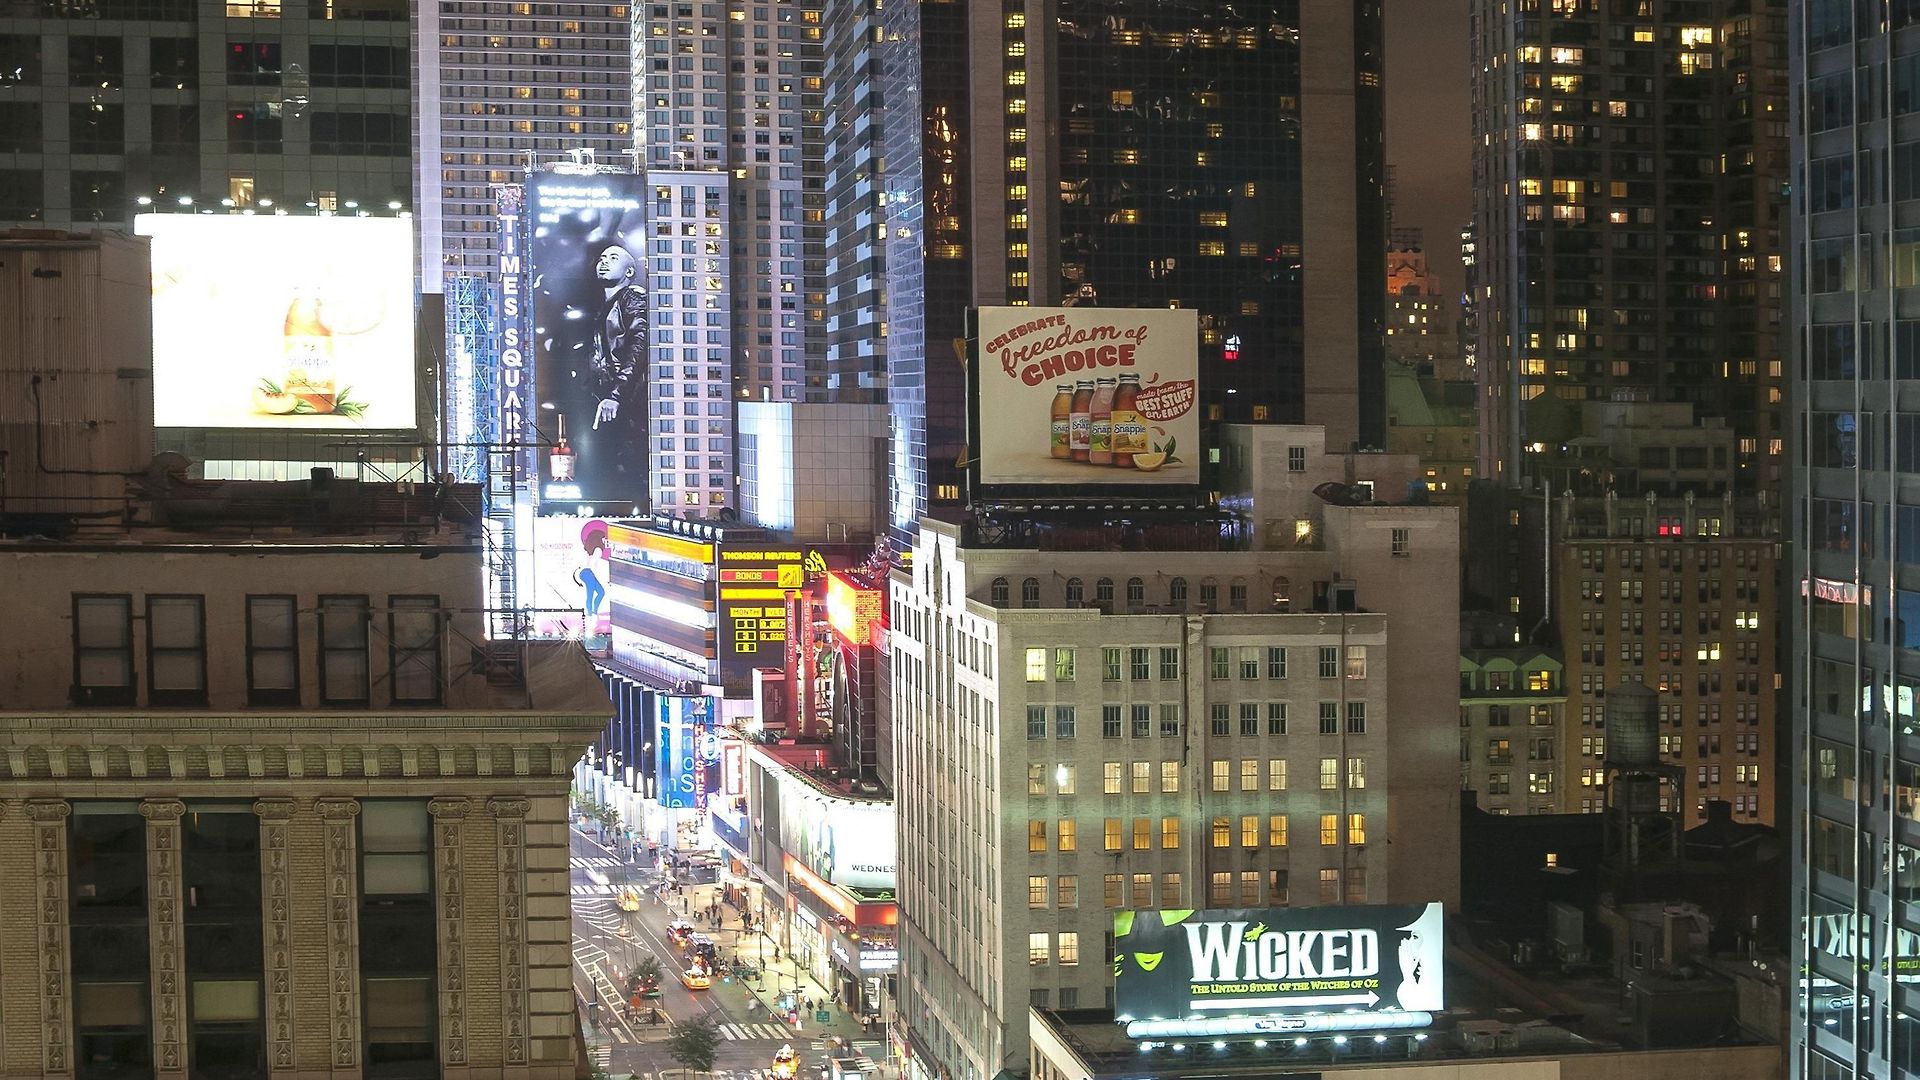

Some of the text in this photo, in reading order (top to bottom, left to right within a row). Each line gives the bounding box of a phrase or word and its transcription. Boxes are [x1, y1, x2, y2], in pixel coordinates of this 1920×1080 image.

[501, 215, 519, 317] TIMES
[986, 314, 1065, 354] CELEBRATE
[1001, 324, 1148, 379] freedom of
[1021, 344, 1136, 386] CHOICE
[1135, 387, 1192, 411] BEST STUFF
[1161, 401, 1190, 418] EARTH
[1114, 424, 1146, 435] Snapple
[722, 552, 802, 560] THOMSON REUTERS
[735, 572, 762, 580] BONDS
[851, 864, 896, 873] WEDNES
[1181, 921, 1379, 982] WICKED
[1190, 979, 1379, 994] THE UNTOLD STORY OF THE WITCHES OF OZ
